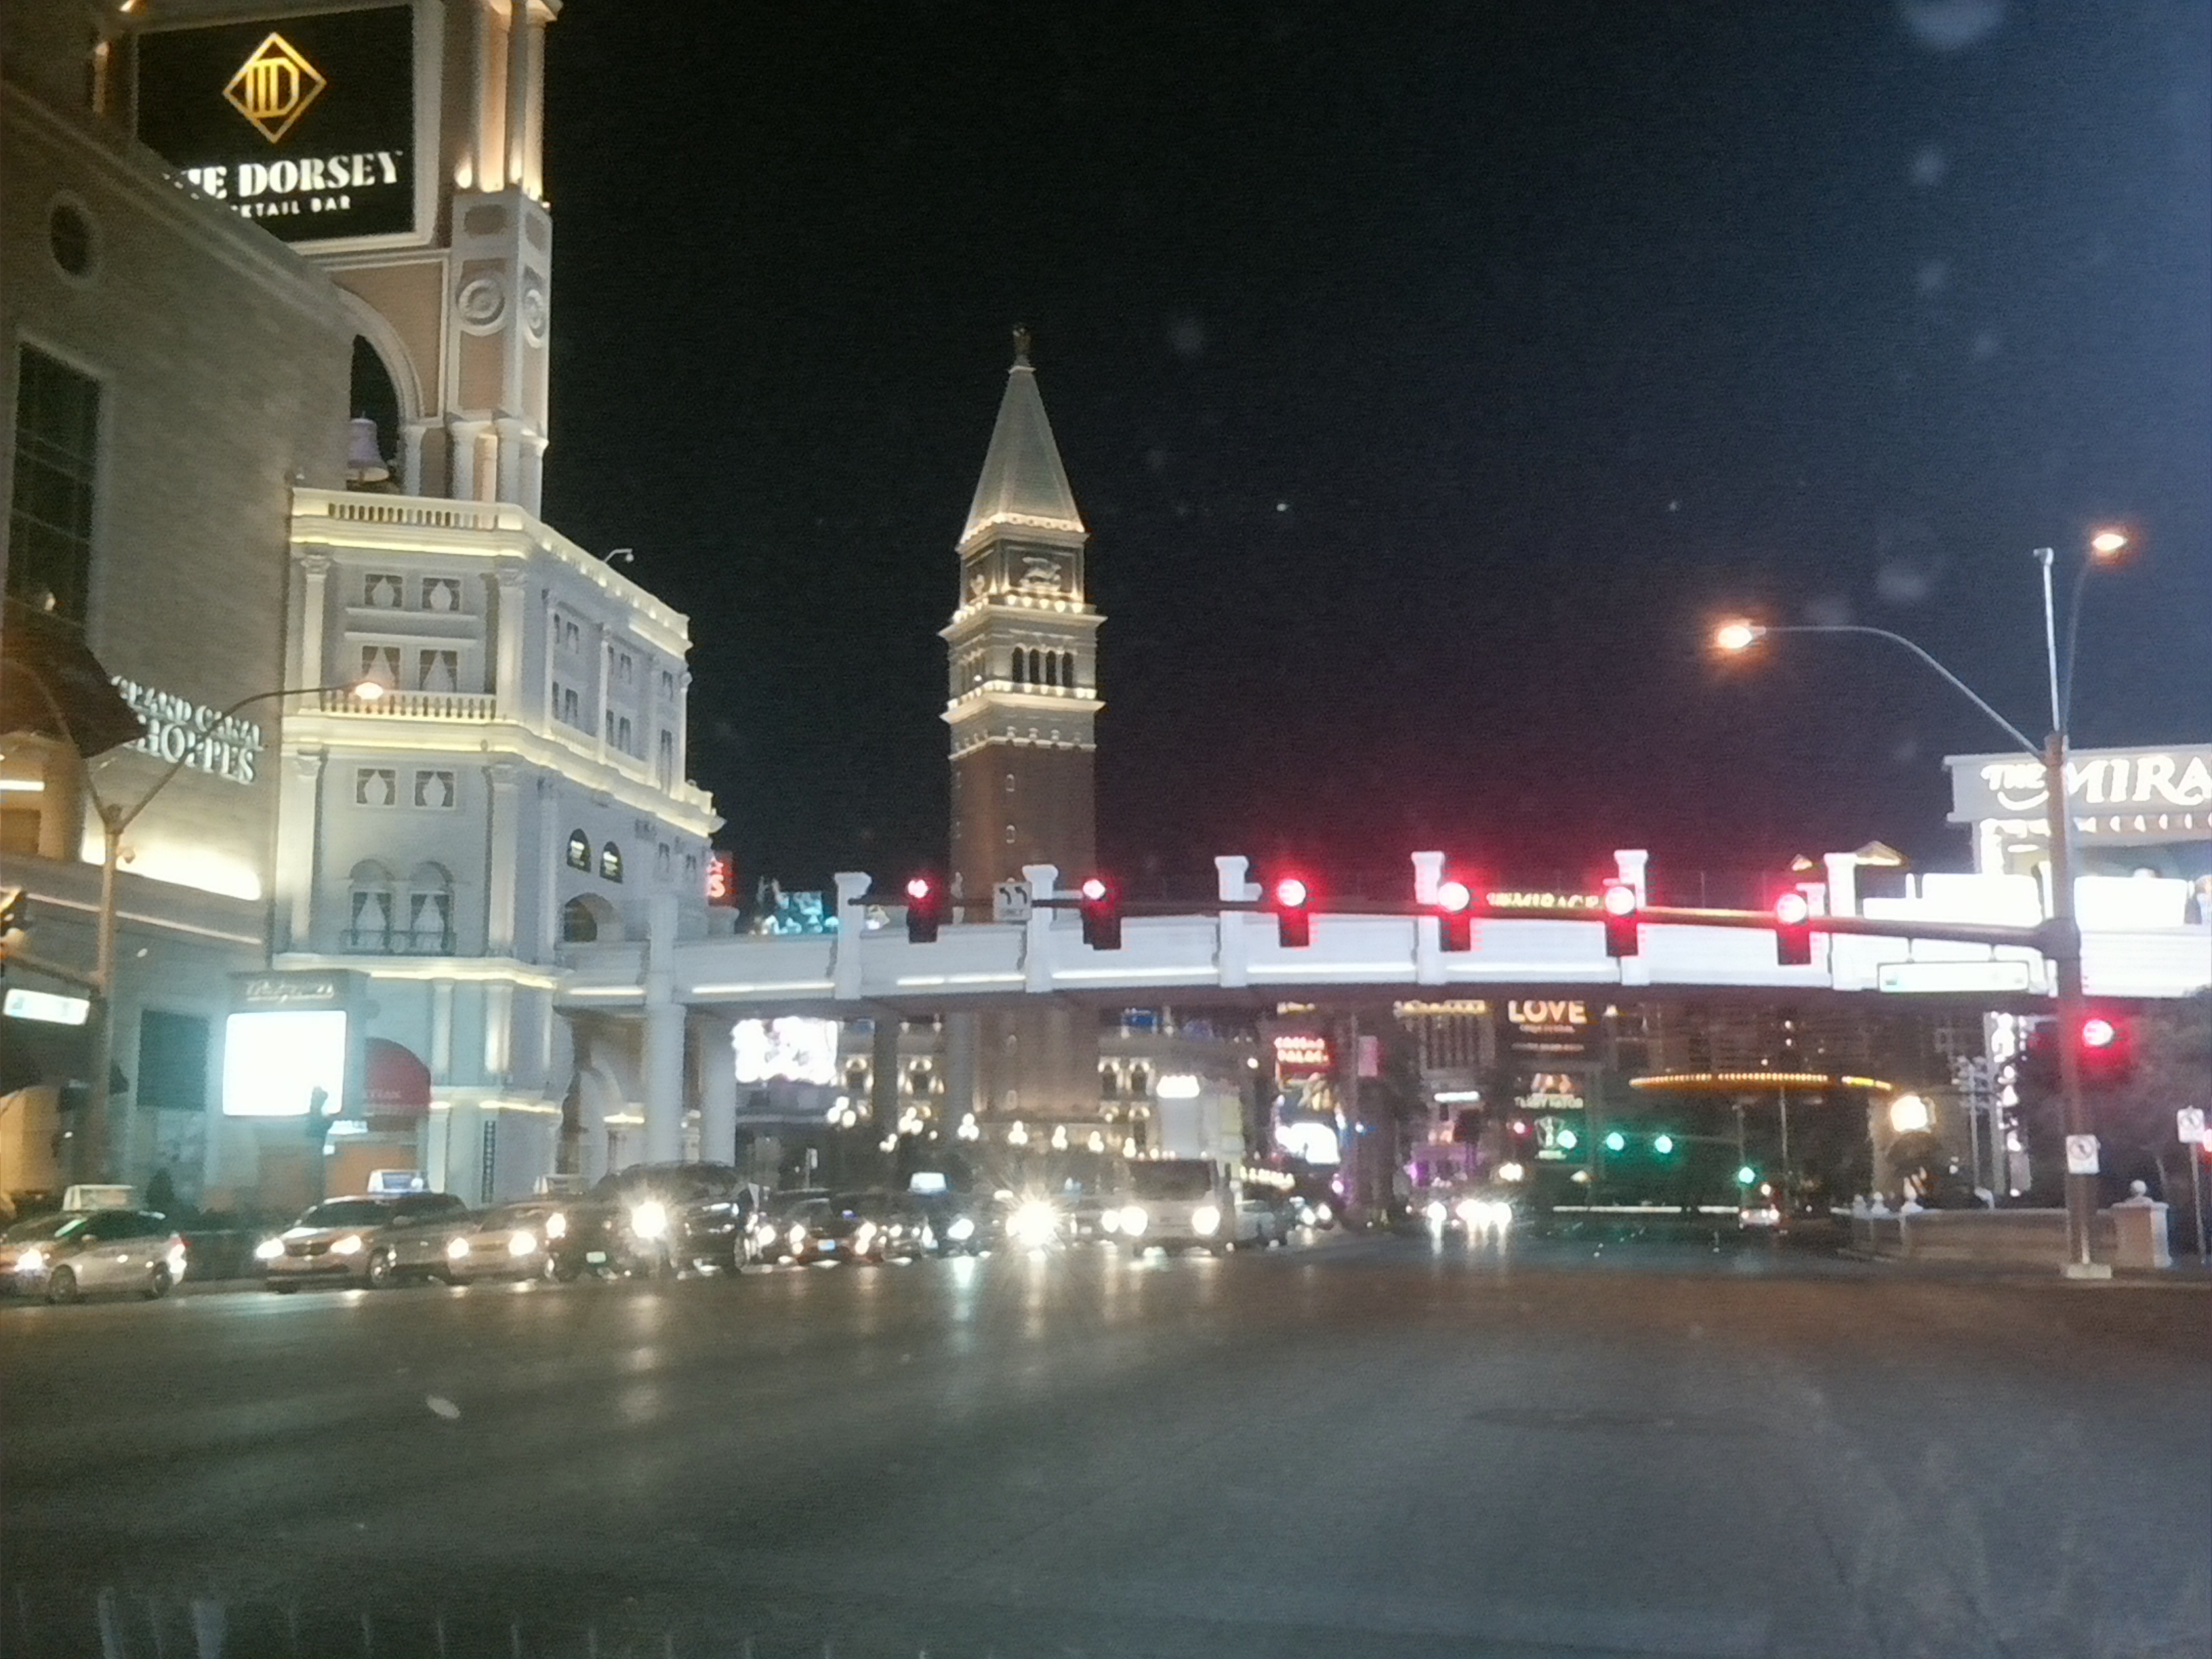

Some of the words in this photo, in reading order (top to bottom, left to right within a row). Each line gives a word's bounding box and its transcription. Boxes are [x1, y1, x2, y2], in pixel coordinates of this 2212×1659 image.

[239, 152, 397, 197] DORSEY
[311, 195, 350, 211] BAR
[122, 712, 255, 785] HOPPES
[1981, 762, 2047, 790] THE
[1508, 1000, 1587, 1024] LOVE
